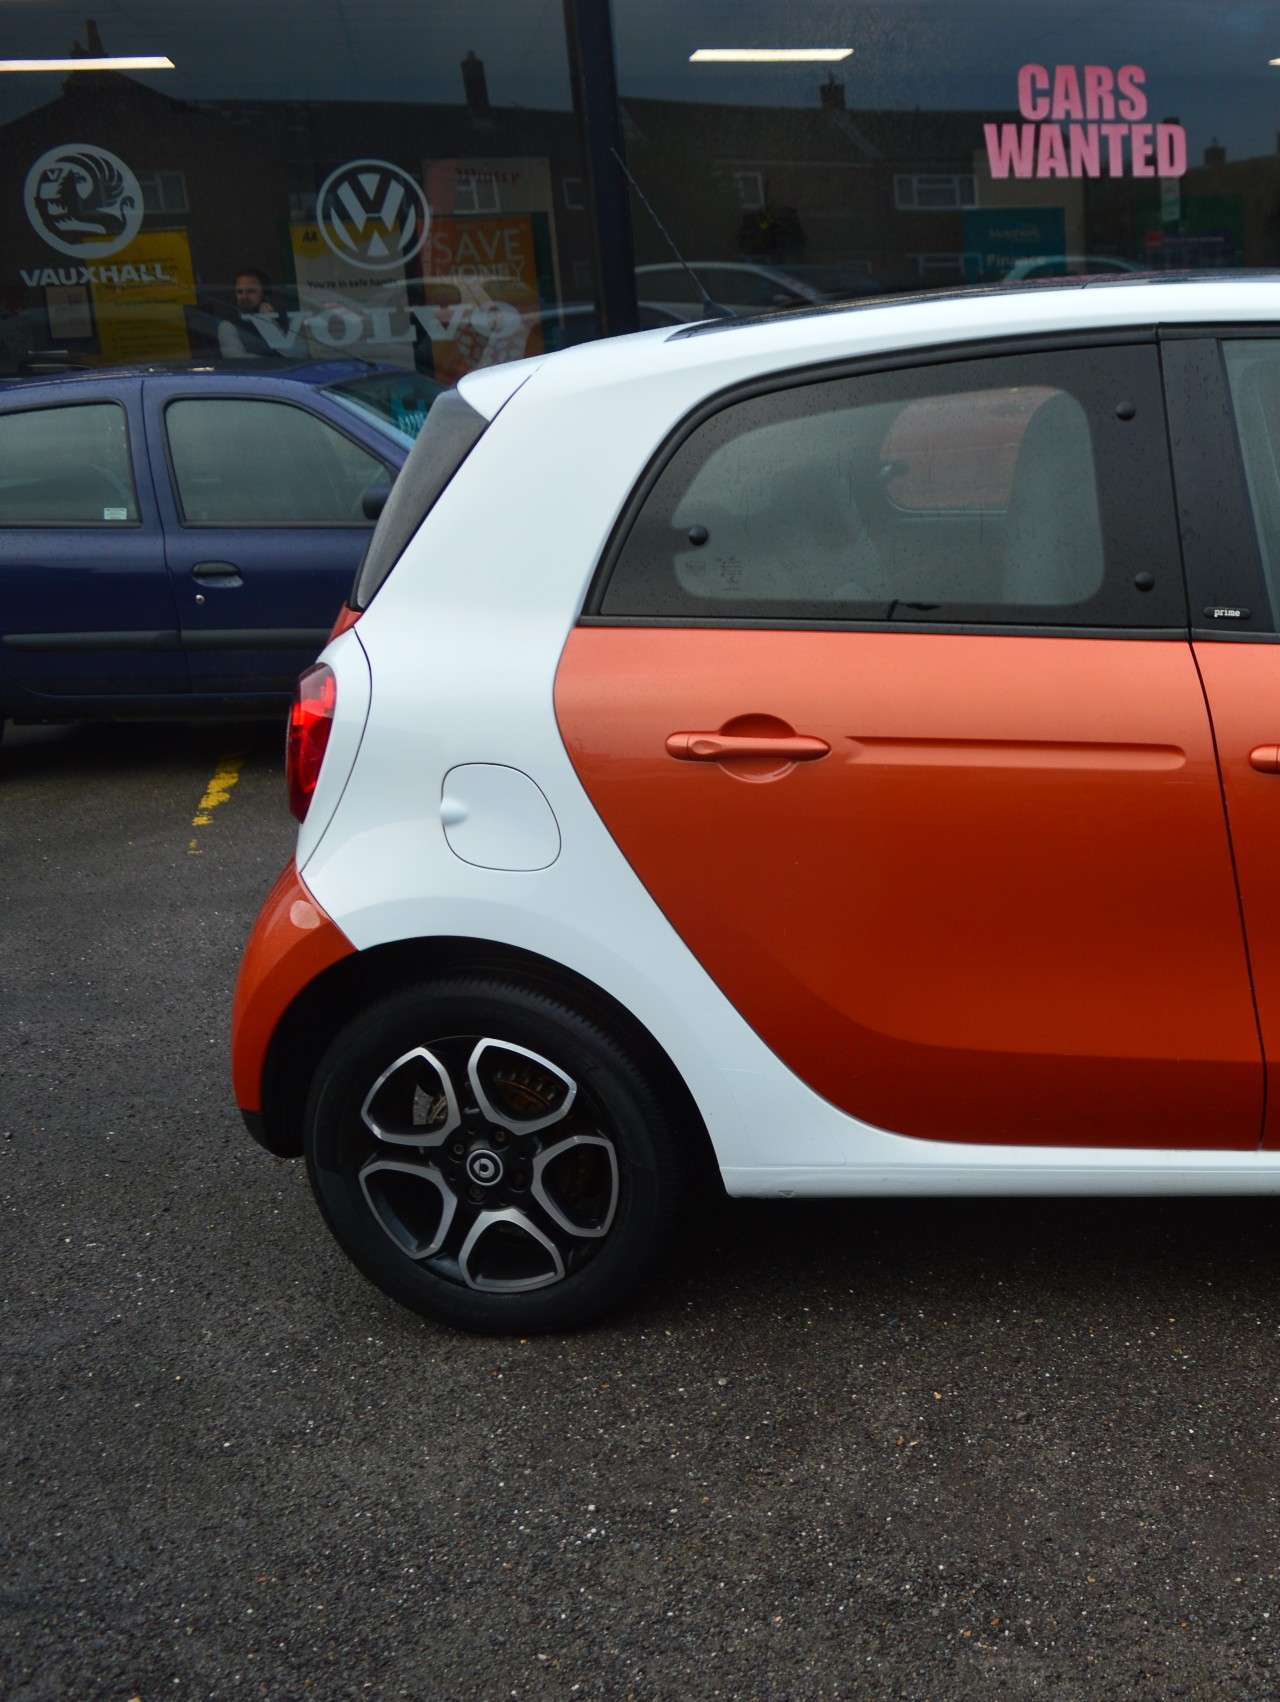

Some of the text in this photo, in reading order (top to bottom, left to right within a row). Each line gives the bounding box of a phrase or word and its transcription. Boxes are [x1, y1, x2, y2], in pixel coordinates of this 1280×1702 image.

[1017, 64, 1147, 122] CARS
[984, 122, 1188, 179] WANTED
[431, 227, 521, 264] SAVE
[19, 263, 171, 288] VAUXHALL
[242, 301, 522, 350] VOLVO
[1213, 608, 1241, 618] prime
